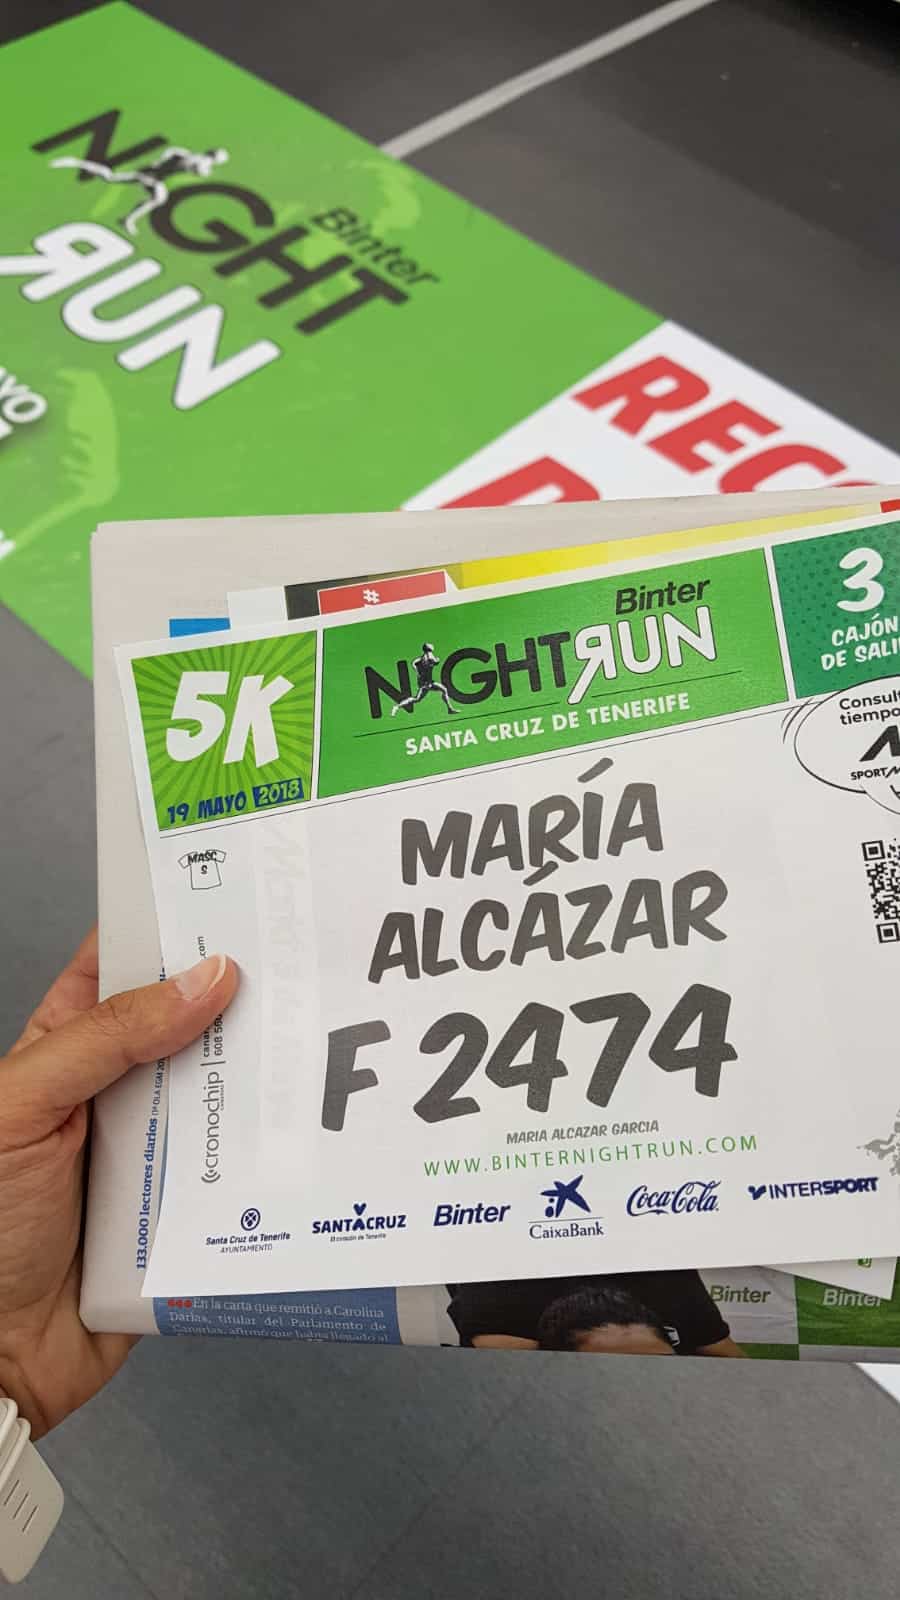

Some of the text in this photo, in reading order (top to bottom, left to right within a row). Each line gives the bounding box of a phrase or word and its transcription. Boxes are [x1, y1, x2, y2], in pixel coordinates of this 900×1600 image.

[311, 207, 441, 287] Binter
[0, 222, 282, 411] RUN
[571, 355, 880, 495] REC
[615, 579, 711, 615] Binter
[837, 547, 885, 612] 3
[831, 612, 899, 647] CAJÓN
[821, 635, 900, 671] DE SALI
[166, 671, 294, 768] 5K
[405, 692, 691, 756] SANTA CRUZ DE TENERIFE
[167, 779, 301, 825] 19 MAYO 2018
[402, 757, 664, 886] MARÍA
[368, 860, 728, 984] ALCÁZAR
[321, 983, 739, 1132] F 2474
[144, 1117, 158, 1162] diarios
[202, 1071, 224, 1169] cronochip
[506, 1119, 660, 1145] MARIA ALCAZAR GARCIA
[424, 1134, 758, 1177] WWW.BINTERNIGHTRUN.COM
[139, 1164, 153, 1217] lectores
[626, 1181, 721, 1217] Coca-Cola
[769, 1177, 879, 1199] INTERSPORT
[433, 1202, 511, 1226] Binter
[529, 1221, 604, 1240] CaixaBank
[136, 1217, 149, 1270] 133.000
[206, 1231, 291, 1246] Santa Cruz de Tenerife
[220, 1243, 273, 1254] AYUNTAMIENTO
[193, 1297, 384, 1318] En la carta que remitió a Carolina
[711, 1285, 771, 1303] Binter
[264, 1316, 283, 1327] del
[291, 1318, 363, 1330] Parlamento
